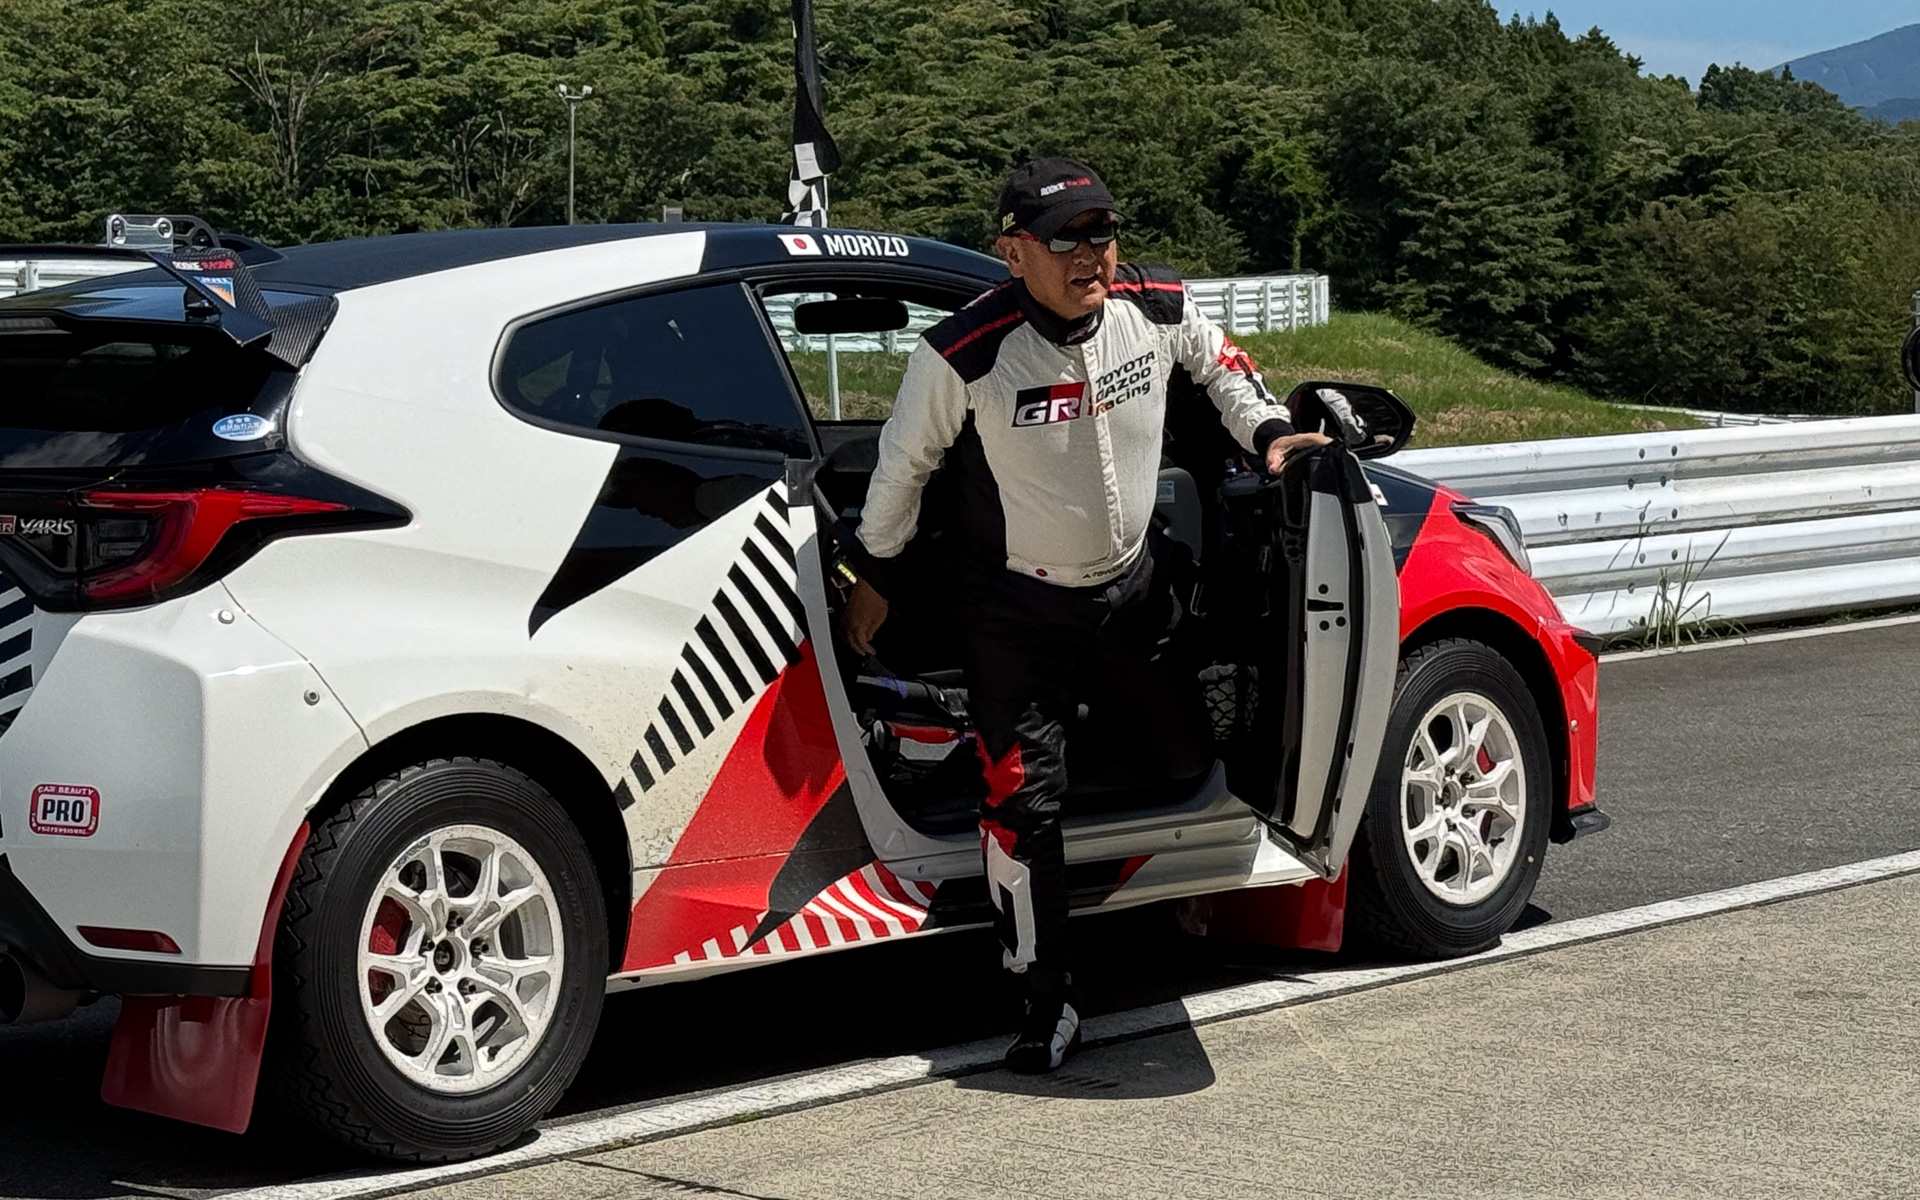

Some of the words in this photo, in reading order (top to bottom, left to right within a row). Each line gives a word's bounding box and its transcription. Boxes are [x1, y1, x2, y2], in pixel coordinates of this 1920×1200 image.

[823, 234, 909, 257] MORIZO
[1095, 351, 1156, 389] TOYOTA
[1094, 367, 1152, 402] GAZOO
[1015, 397, 1080, 426] GR
[1089, 381, 1151, 417] Racing
[19, 518, 75, 536] YARIS
[58, 787, 94, 796] BEAUTY
[42, 799, 85, 823] PRO
